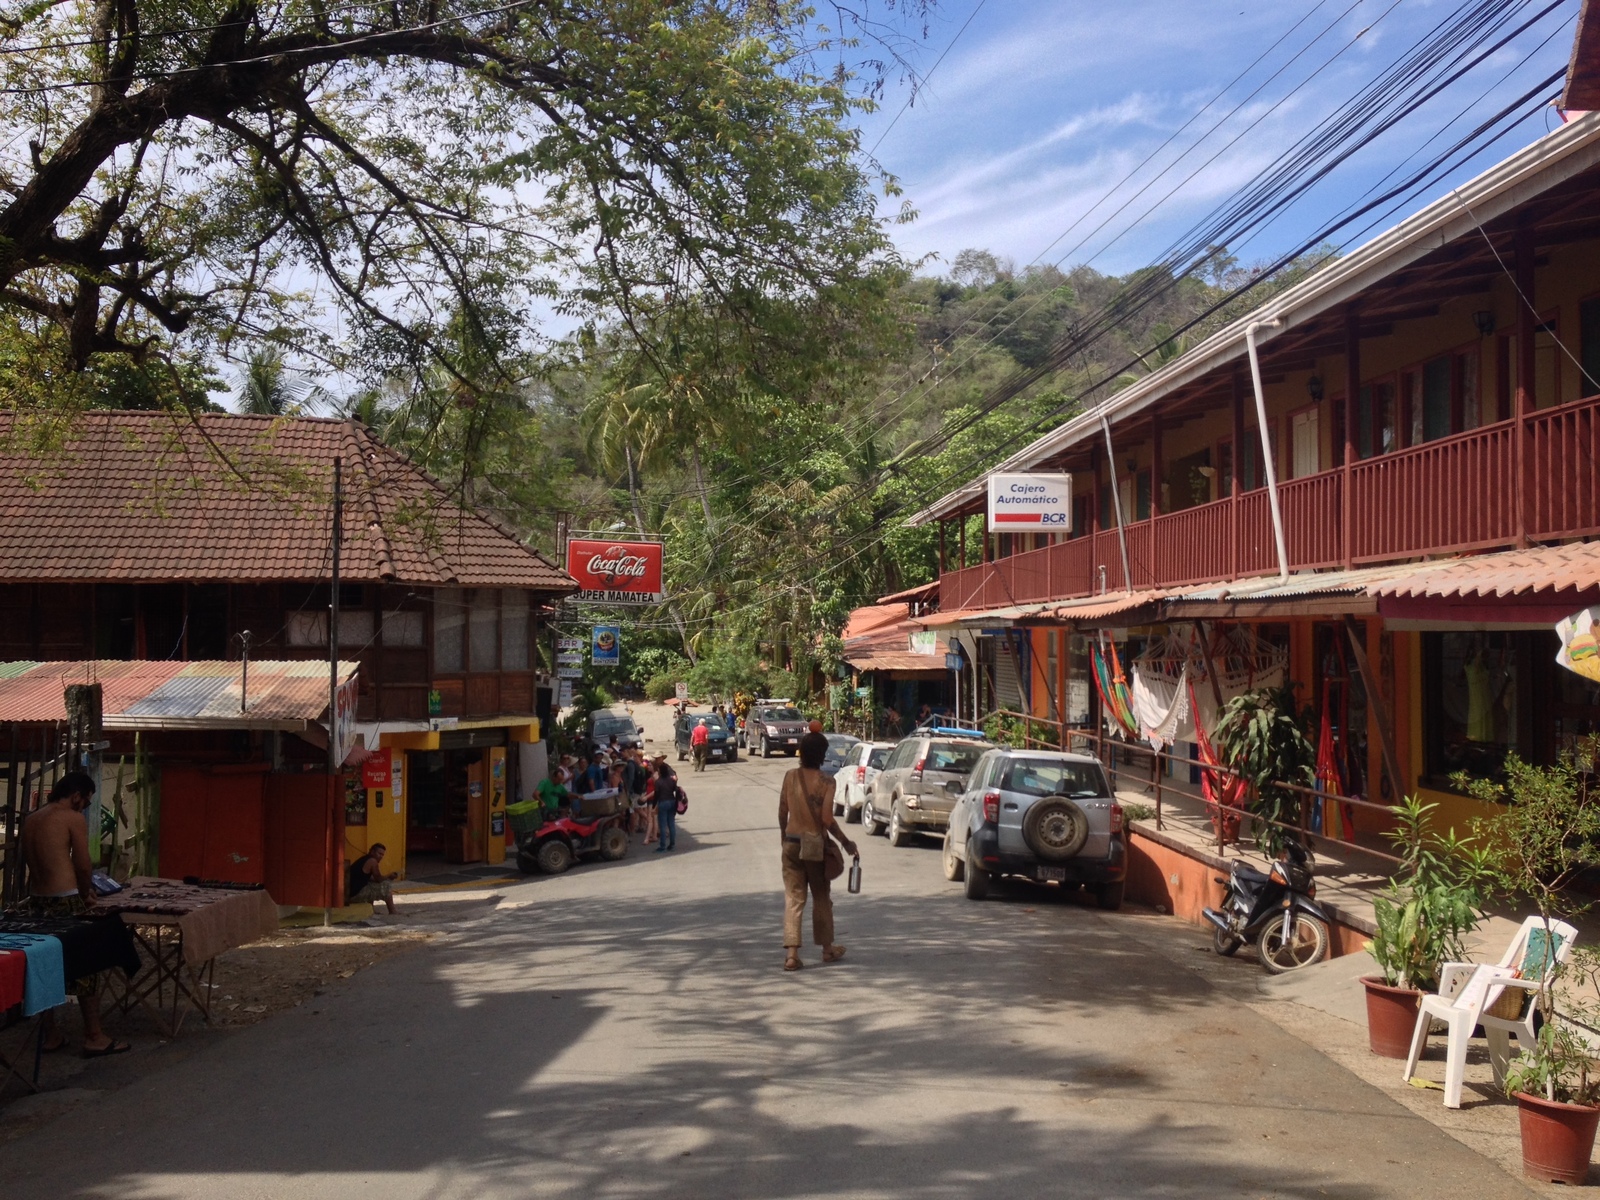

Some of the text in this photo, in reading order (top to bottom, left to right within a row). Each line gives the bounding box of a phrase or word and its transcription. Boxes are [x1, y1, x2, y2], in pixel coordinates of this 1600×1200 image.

[1010, 484, 1046, 494] Cajero
[996, 495, 1058, 504] Automático
[1042, 513, 1066, 523] BCR
[572, 590, 654, 603] SUPER MAMATEA
